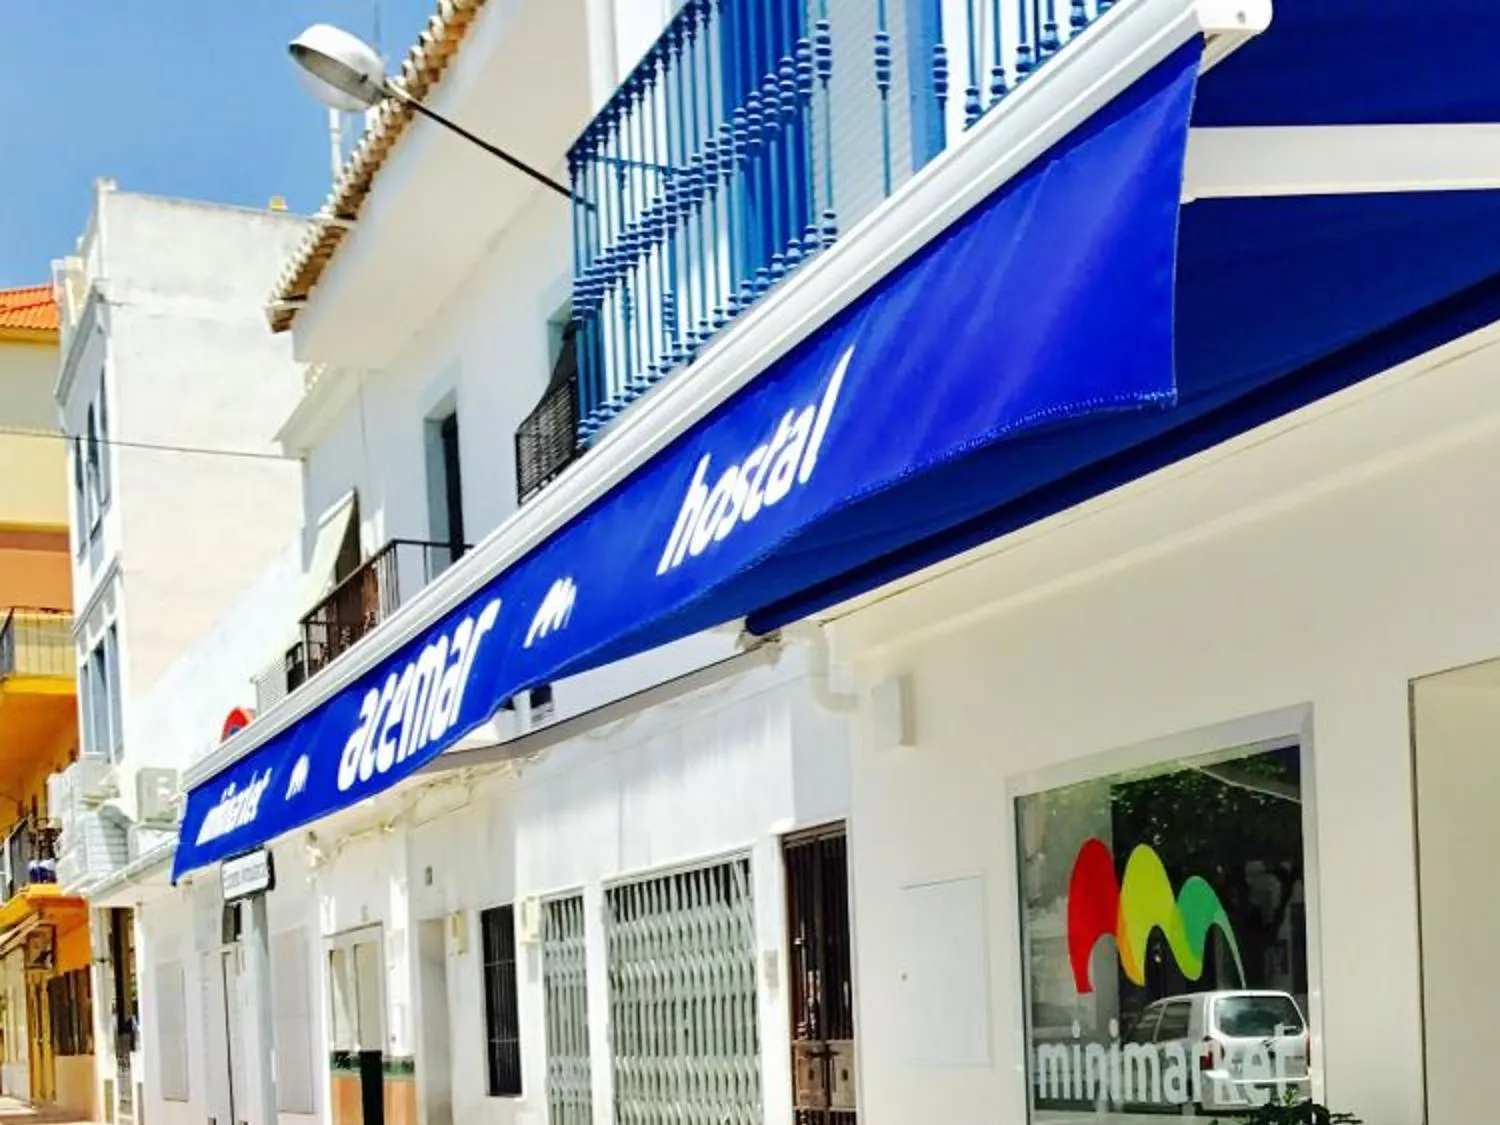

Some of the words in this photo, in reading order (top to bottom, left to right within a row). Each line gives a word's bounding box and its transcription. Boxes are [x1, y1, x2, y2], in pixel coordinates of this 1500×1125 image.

[656, 344, 855, 577] hostal
[337, 598, 502, 791] acemar
[1038, 1018, 1294, 1107] minimarket
